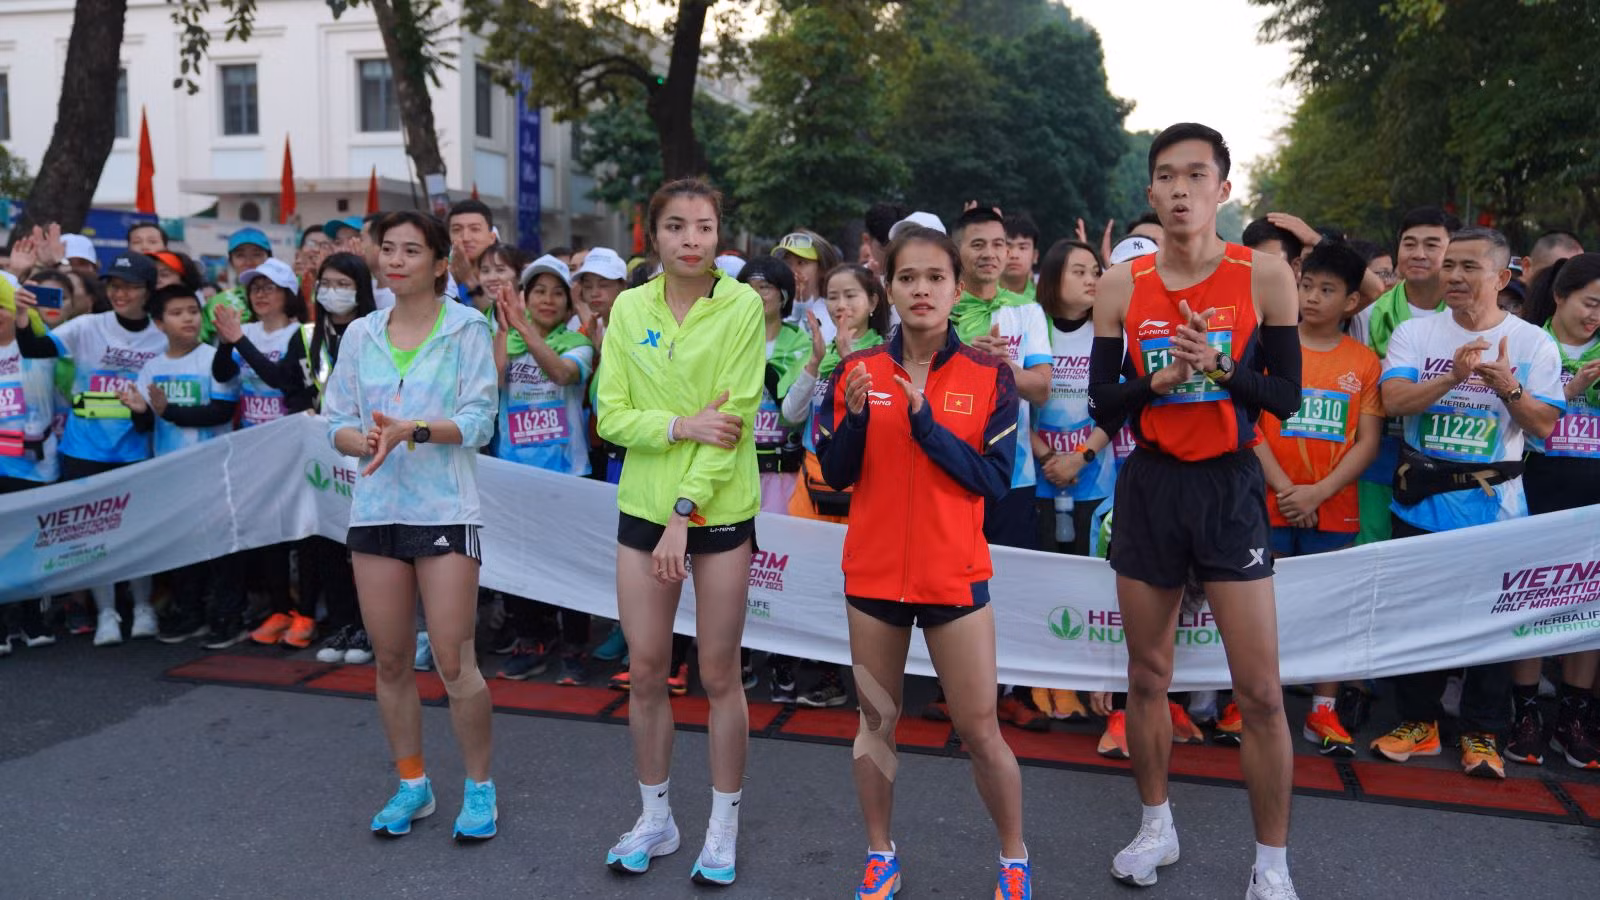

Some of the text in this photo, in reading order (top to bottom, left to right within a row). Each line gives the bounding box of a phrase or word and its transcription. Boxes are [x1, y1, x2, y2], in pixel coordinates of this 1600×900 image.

[1138, 328, 1170, 336] LI-NING
[1440, 399, 1491, 411] HERBALIFE
[515, 409, 559, 432] 16238
[1431, 414, 1488, 441] 11222
[1045, 430, 1088, 453] 16196
[37, 491, 131, 529] VIETNAM
[764, 581, 784, 592] 2023
[1496, 580, 1600, 605] INTERNATIO
[1490, 601, 1528, 615] HALF
